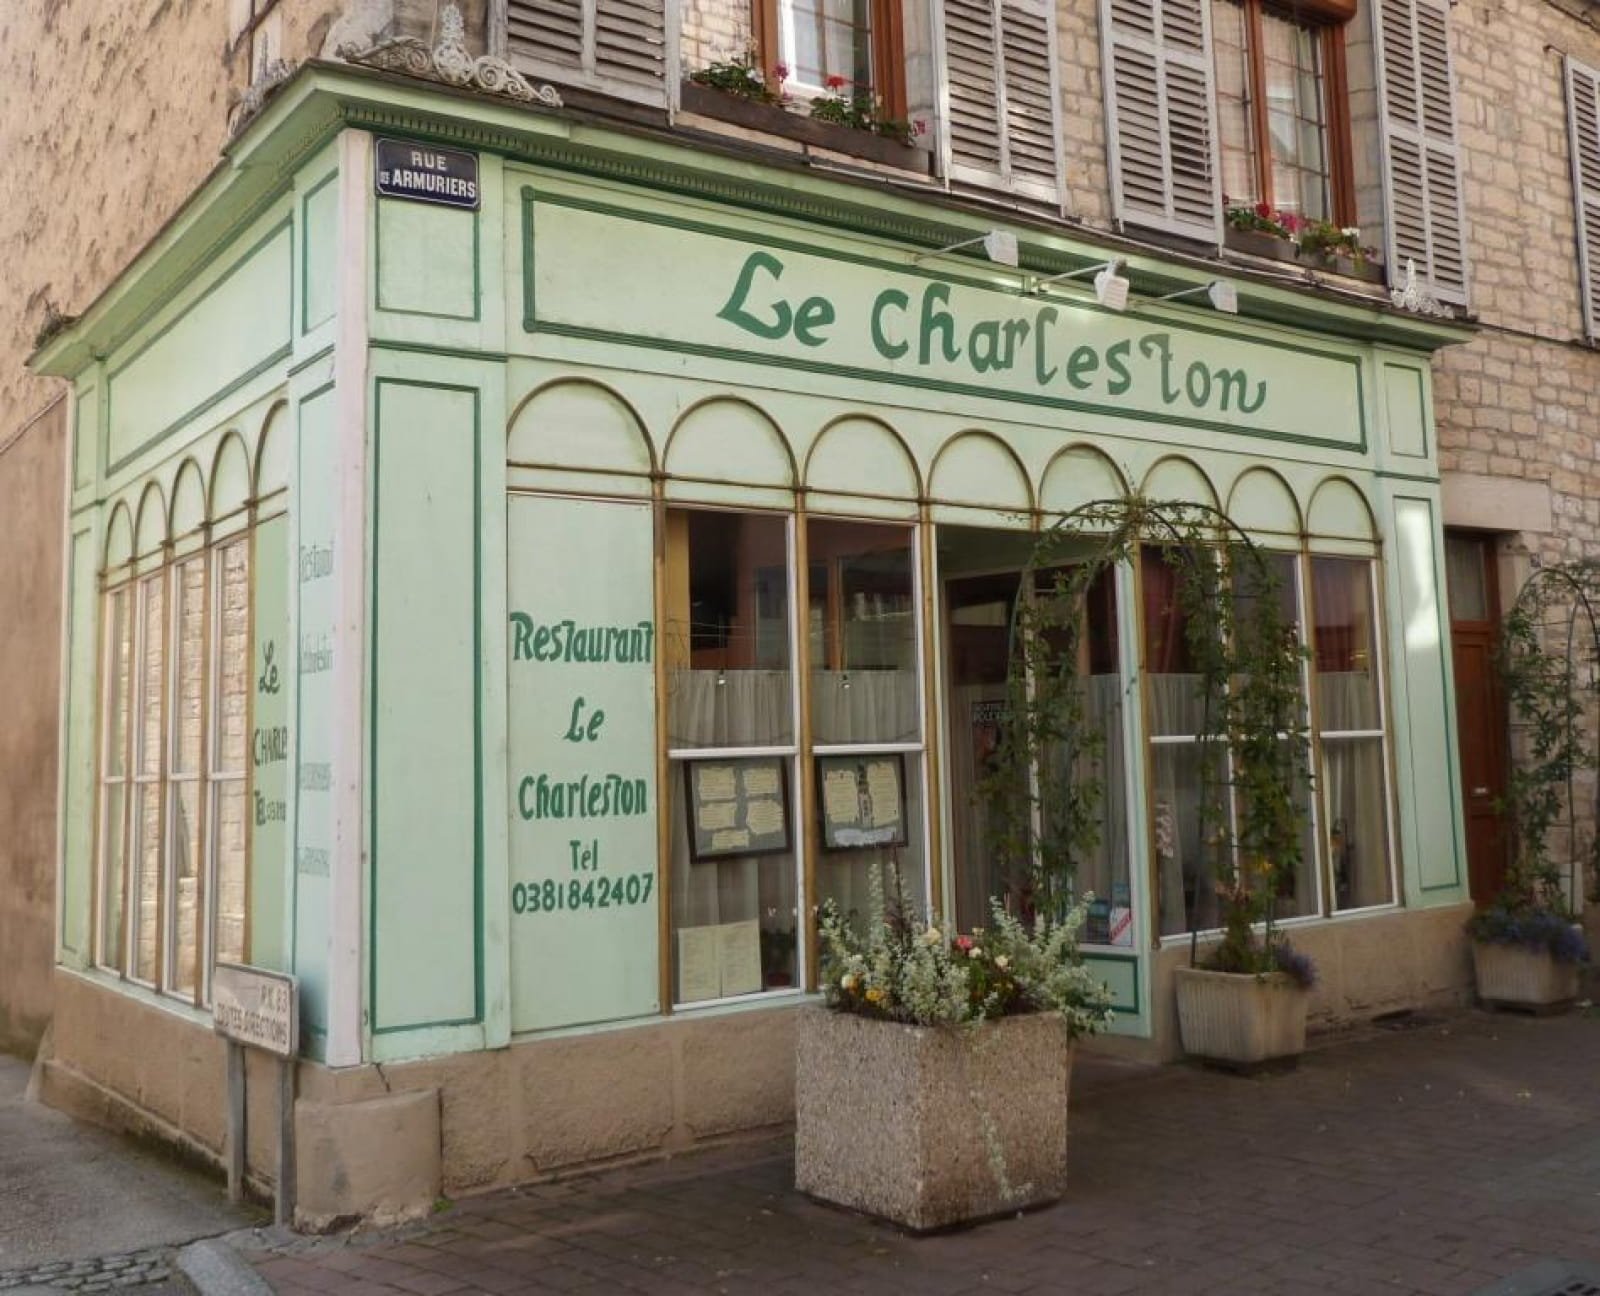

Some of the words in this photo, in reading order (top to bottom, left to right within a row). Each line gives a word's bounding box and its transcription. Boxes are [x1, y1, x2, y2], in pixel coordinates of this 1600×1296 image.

[392, 168, 476, 198] ARMURIERS
[411, 151, 448, 171] RUE
[716, 250, 836, 346] Le
[870, 282, 1267, 414] Charleston
[509, 612, 654, 663] Restaurant
[258, 639, 280, 694] Le
[563, 696, 605, 743] Le
[518, 774, 647, 820] Charleston
[569, 839, 598, 871] Tel
[512, 872, 653, 914] 0381842407
